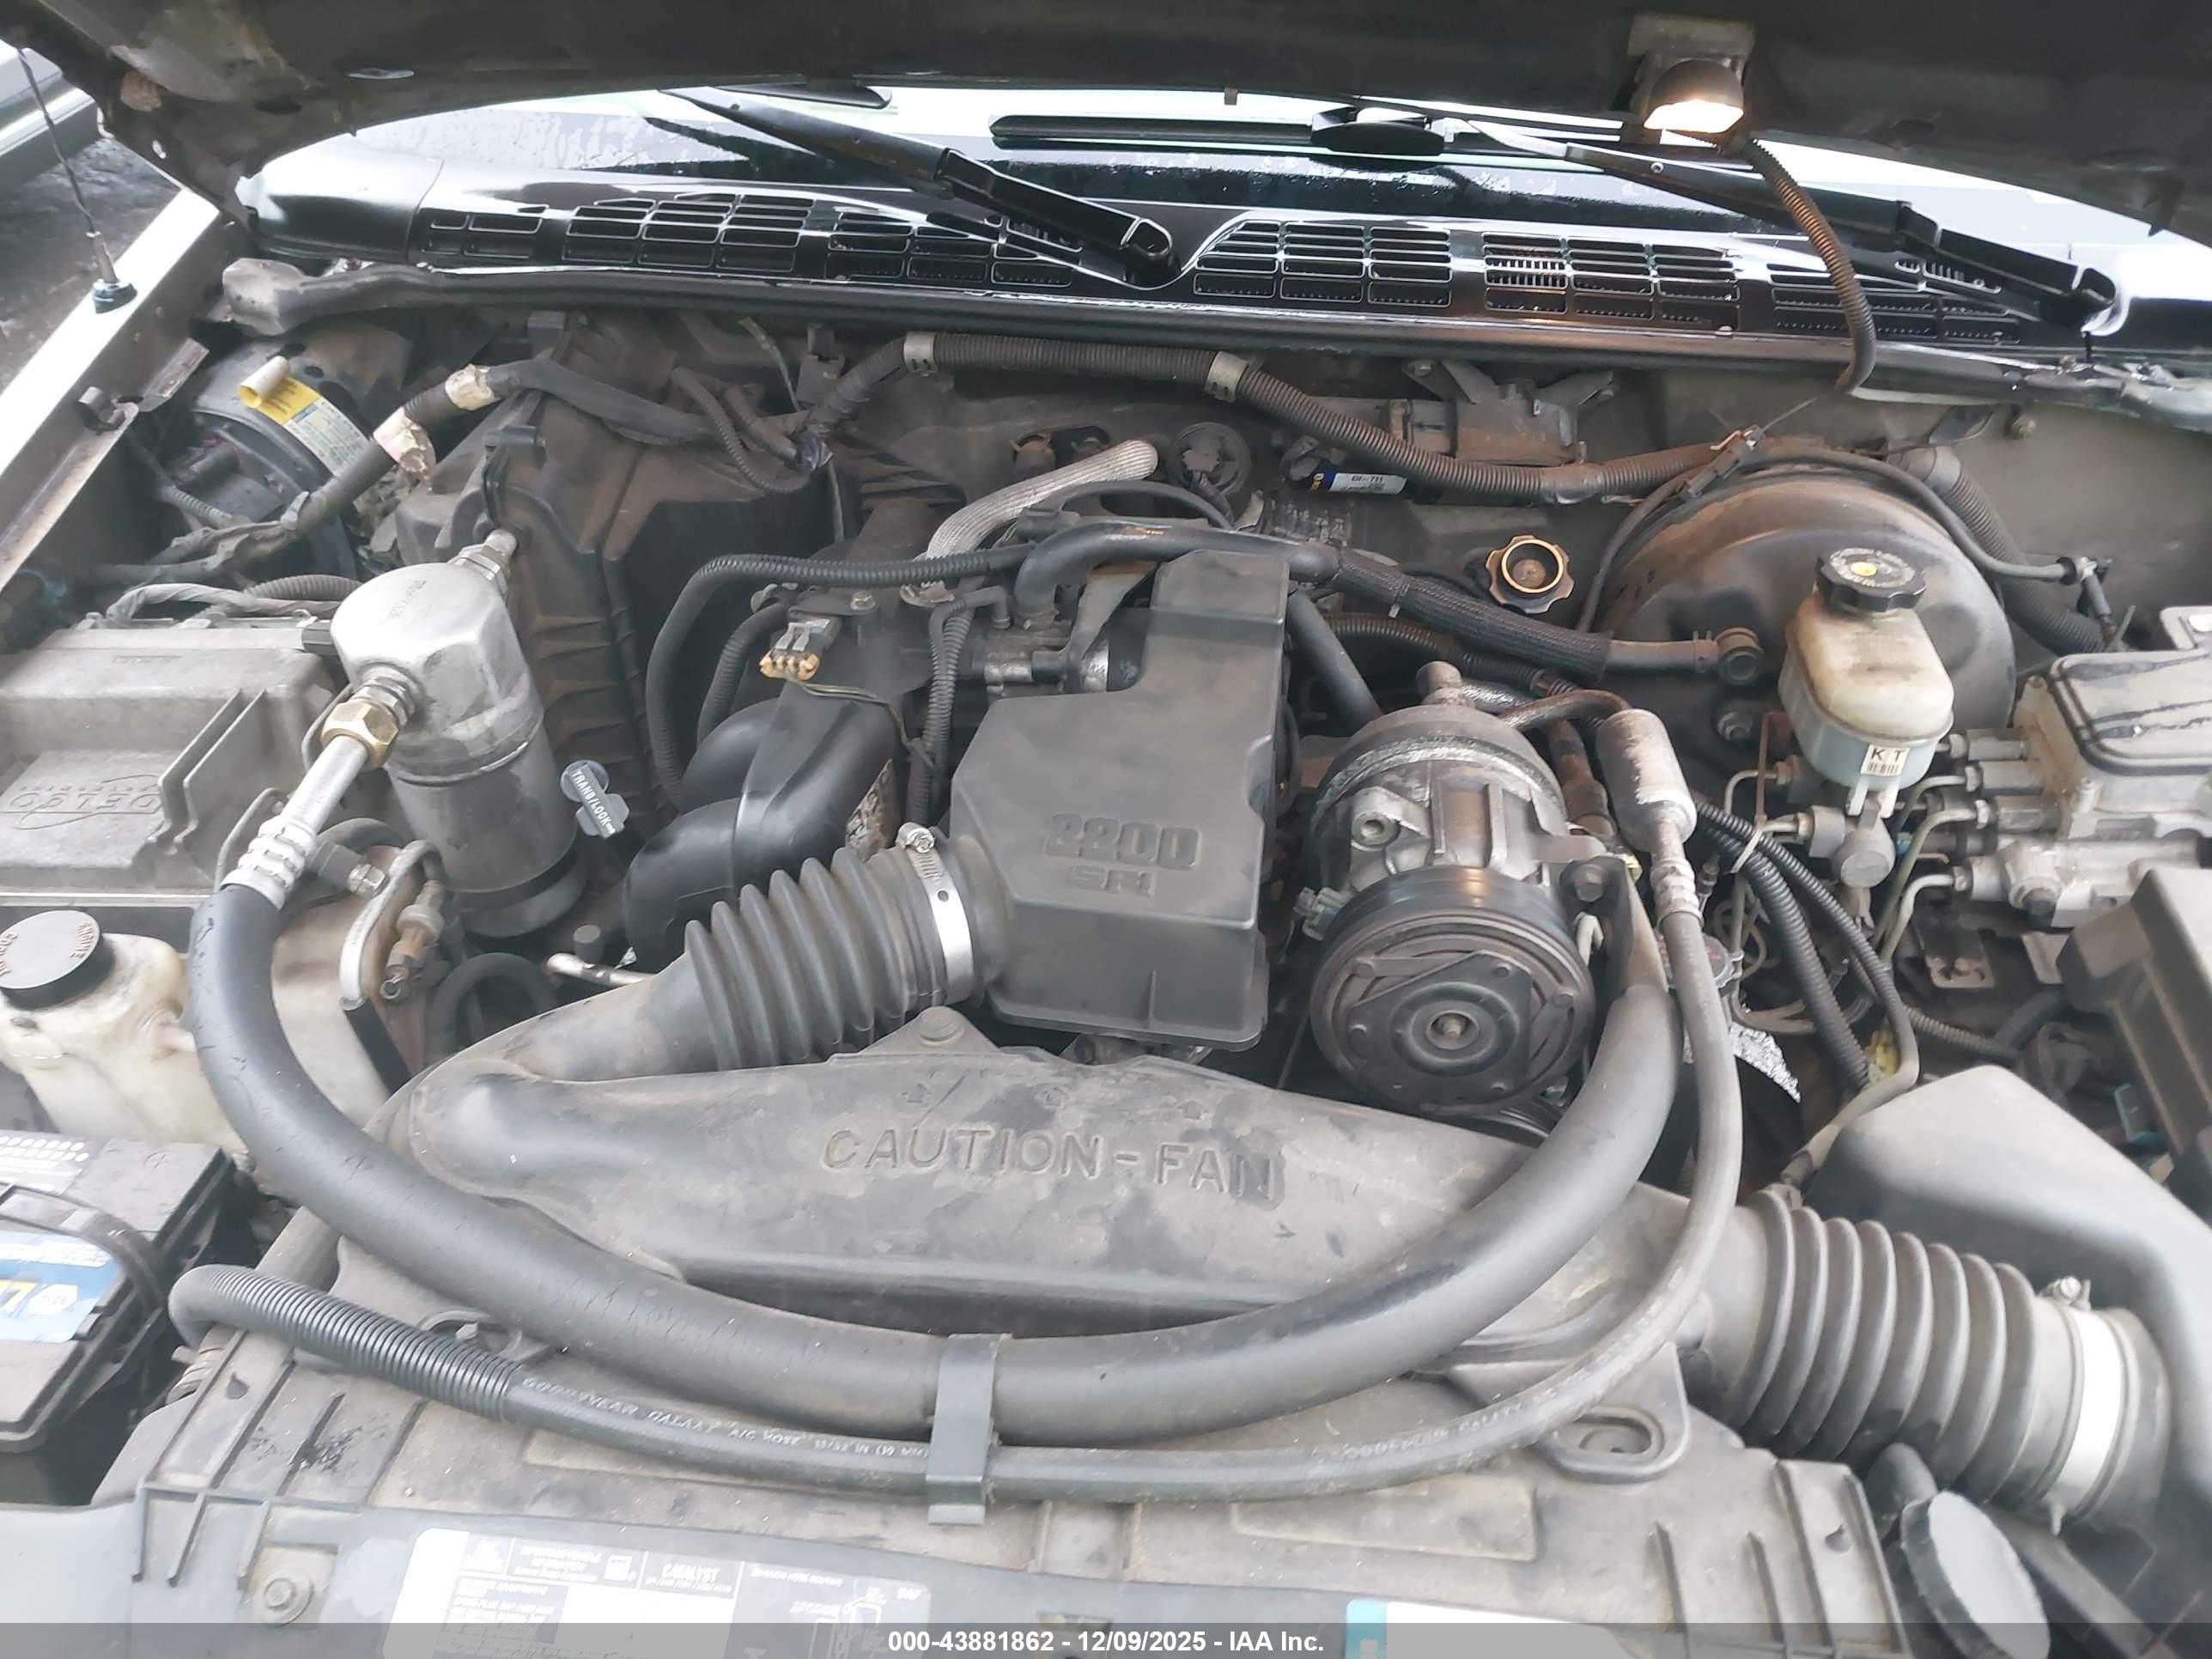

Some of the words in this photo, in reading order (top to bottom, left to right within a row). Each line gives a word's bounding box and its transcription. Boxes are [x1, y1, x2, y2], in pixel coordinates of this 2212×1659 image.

[1871, 748, 1886, 761] K
[1894, 750, 1907, 763] T
[1044, 812, 1202, 872] 2200
